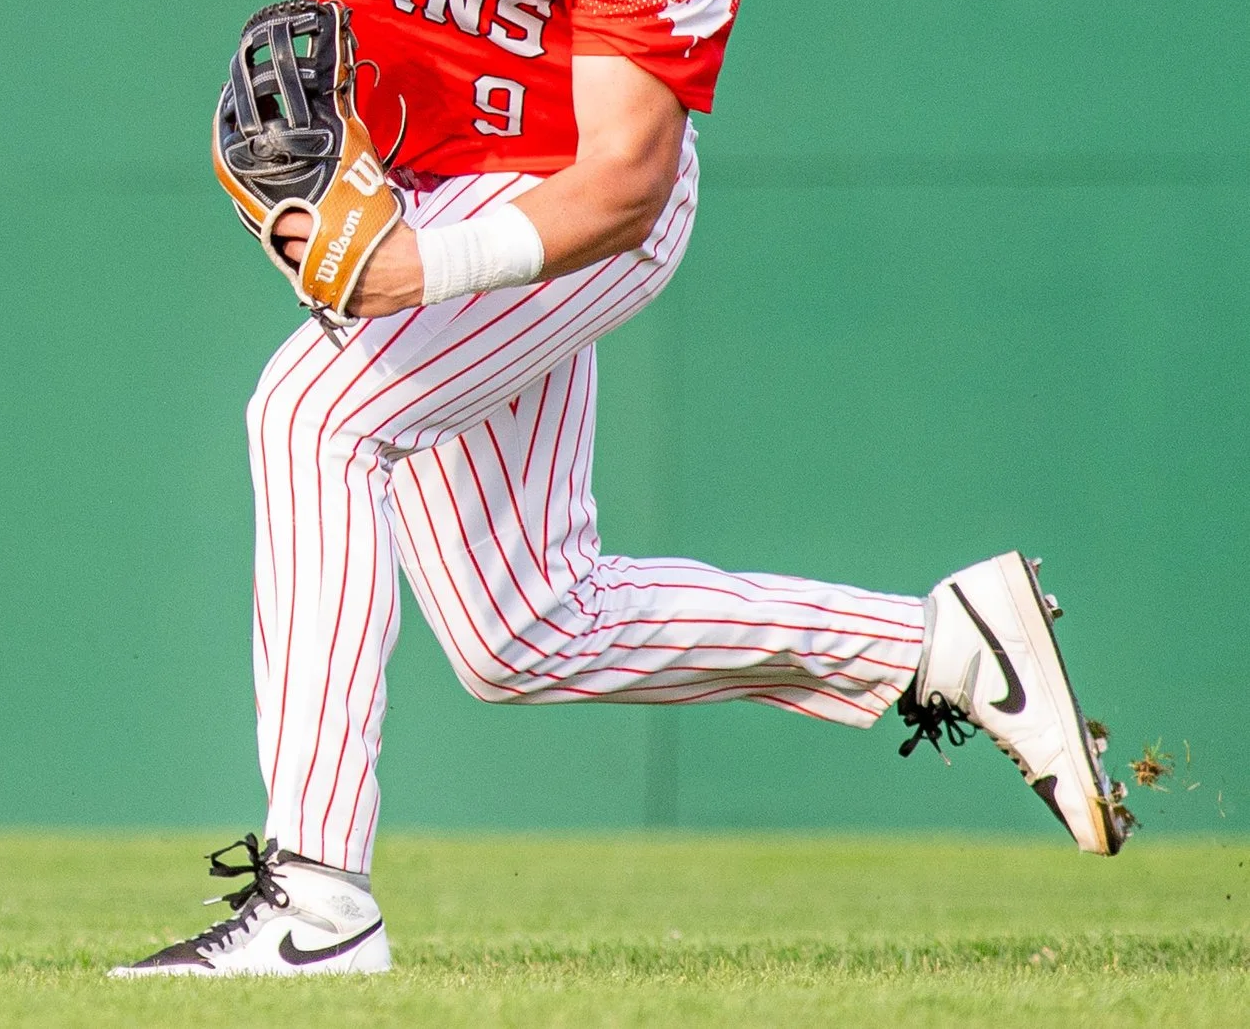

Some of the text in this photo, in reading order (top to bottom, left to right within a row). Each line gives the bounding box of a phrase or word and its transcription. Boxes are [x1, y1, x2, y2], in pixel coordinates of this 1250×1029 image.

[472, 74, 526, 138] 9
[341, 150, 385, 197] W
[314, 208, 363, 284] Wilson
